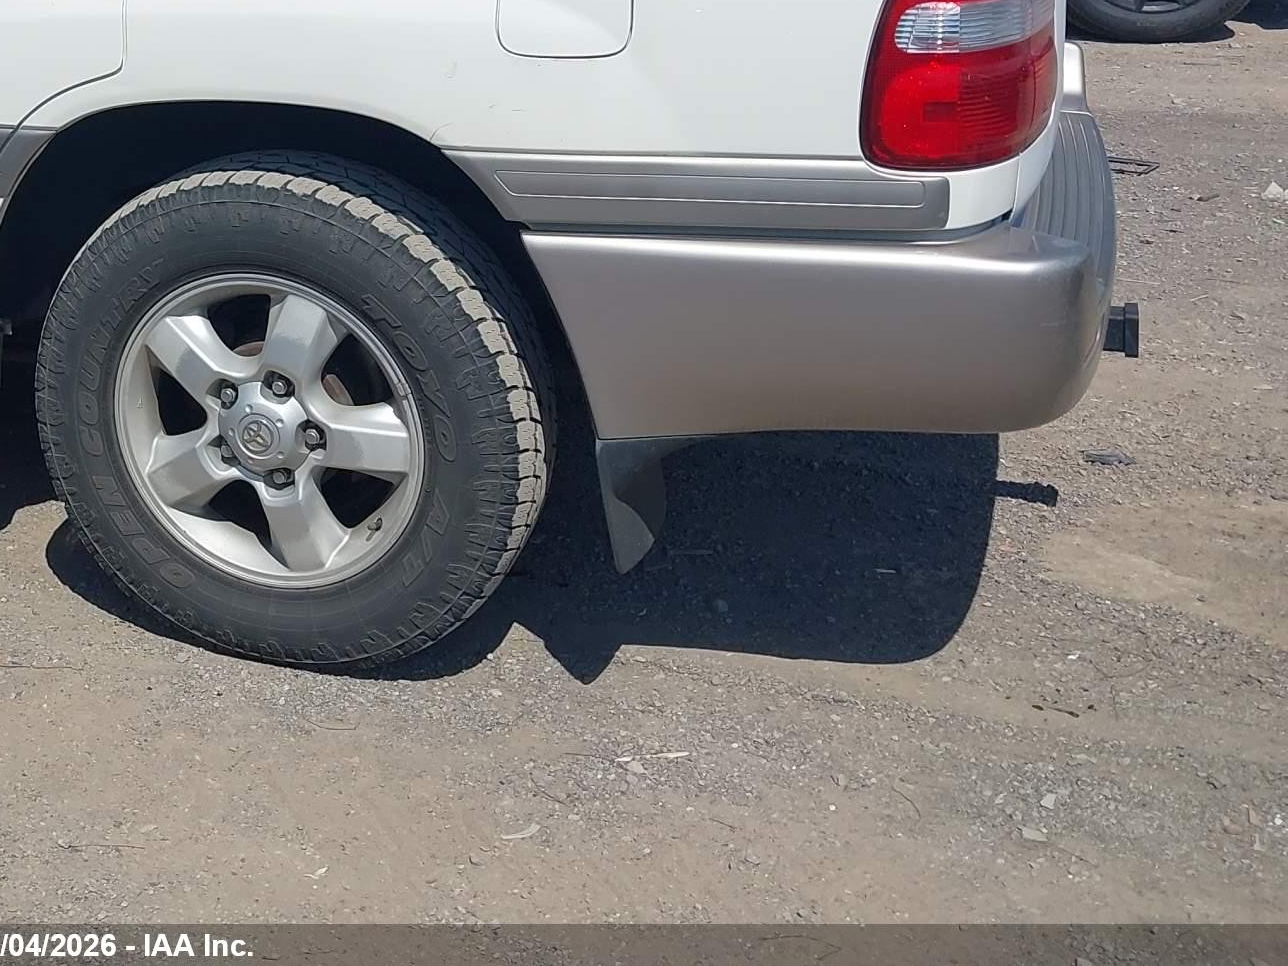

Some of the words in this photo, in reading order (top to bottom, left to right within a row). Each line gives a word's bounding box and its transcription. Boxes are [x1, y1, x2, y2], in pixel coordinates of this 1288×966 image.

[78, 257, 165, 457] COUNTRY
[362, 294, 457, 462] TOYO
[92, 475, 196, 588] OPEN
